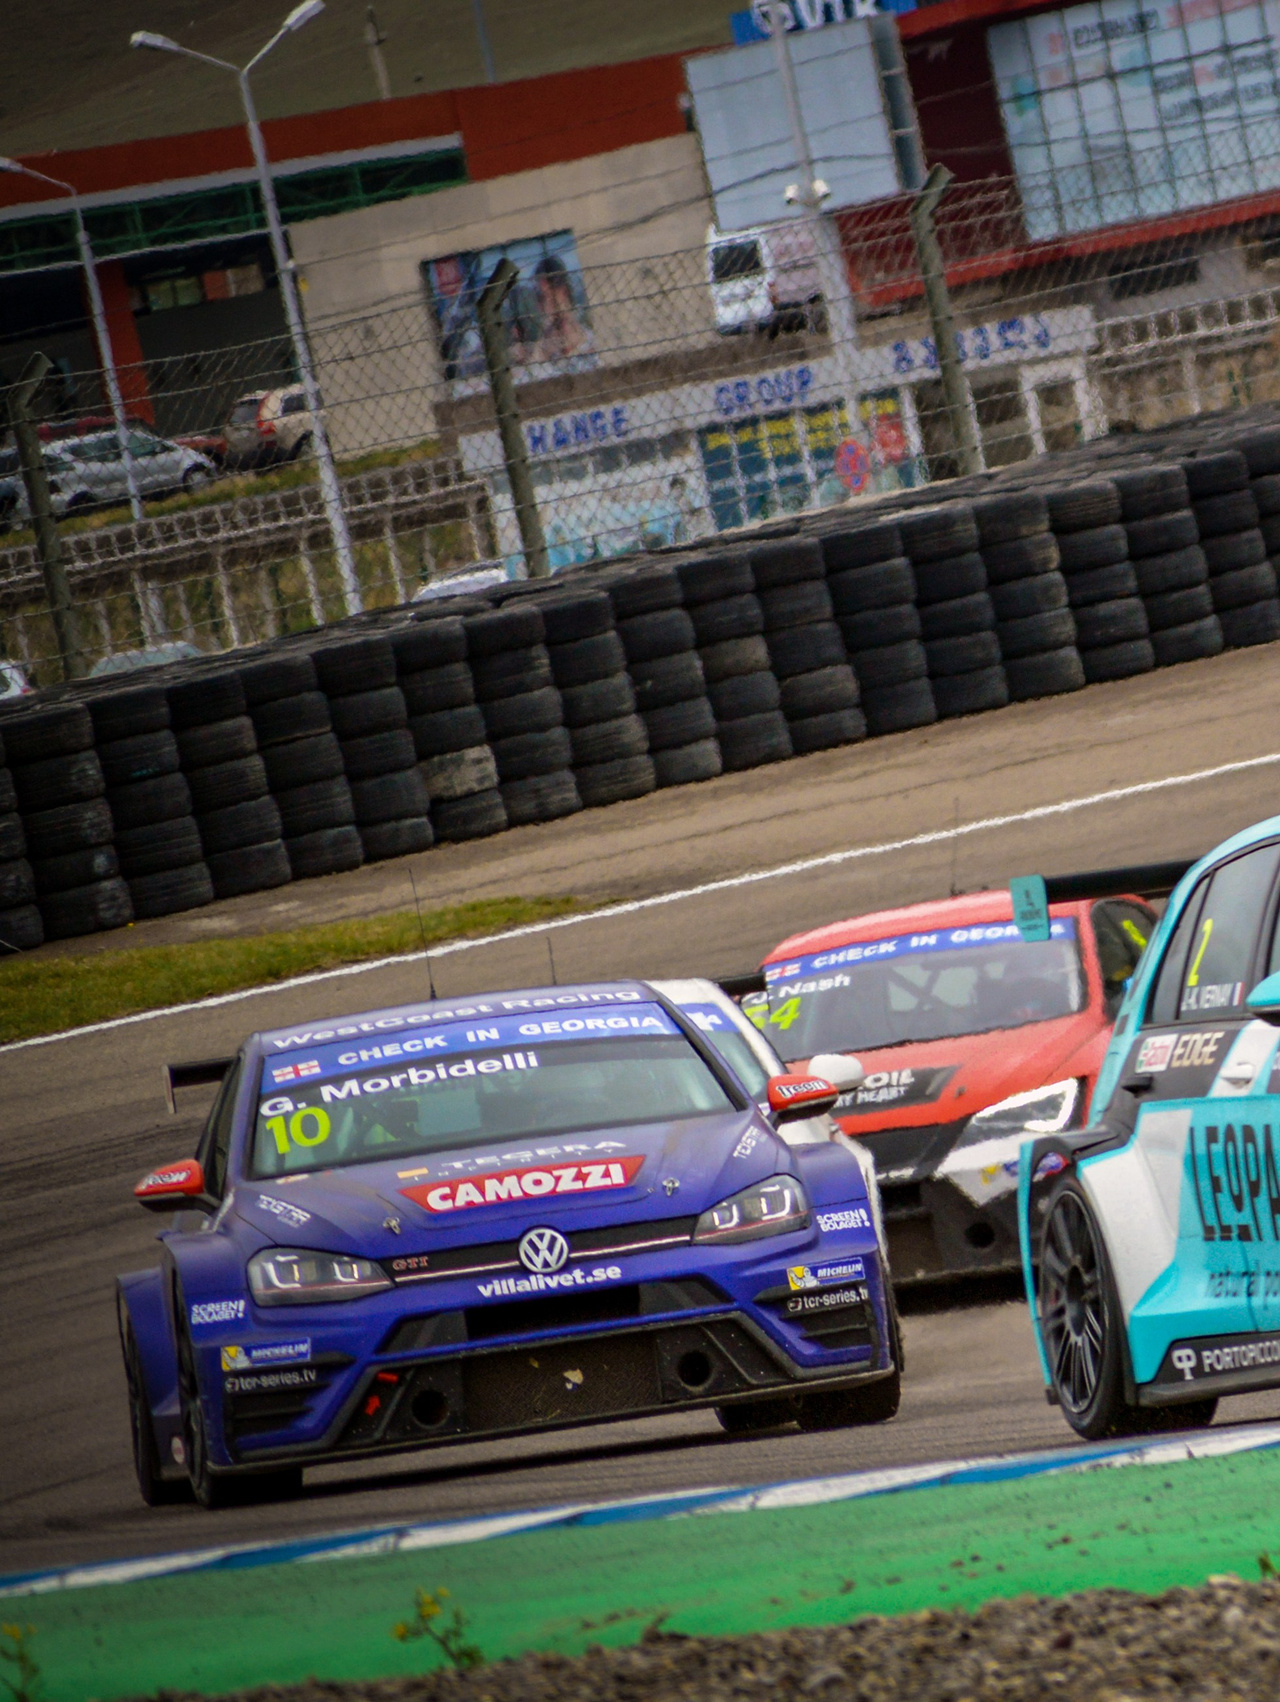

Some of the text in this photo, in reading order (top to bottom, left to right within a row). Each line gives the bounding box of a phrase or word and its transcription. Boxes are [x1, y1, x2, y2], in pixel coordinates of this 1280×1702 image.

[811, 924, 1066, 969] CHECK IN GEORA
[778, 973, 851, 998] Nash
[272, 990, 642, 1049] WestCoast Racing
[337, 1035, 449, 1066] CHECK
[465, 1027, 500, 1043] IN
[518, 1015, 664, 1037] GEORGIA
[1171, 1031, 1225, 1068] EDGE
[259, 1051, 540, 1119] G. Morbidelli
[775, 1080, 829, 1099] freem
[857, 1086, 909, 1104] HEART
[265, 1105, 331, 1155] 10
[441, 1141, 627, 1169] TEGERA
[426, 1163, 625, 1211] CAMOZZI
[392, 1256, 430, 1272] GTI
[816, 1263, 863, 1278] MICHELIN
[477, 1265, 622, 1299] villalivet.se
